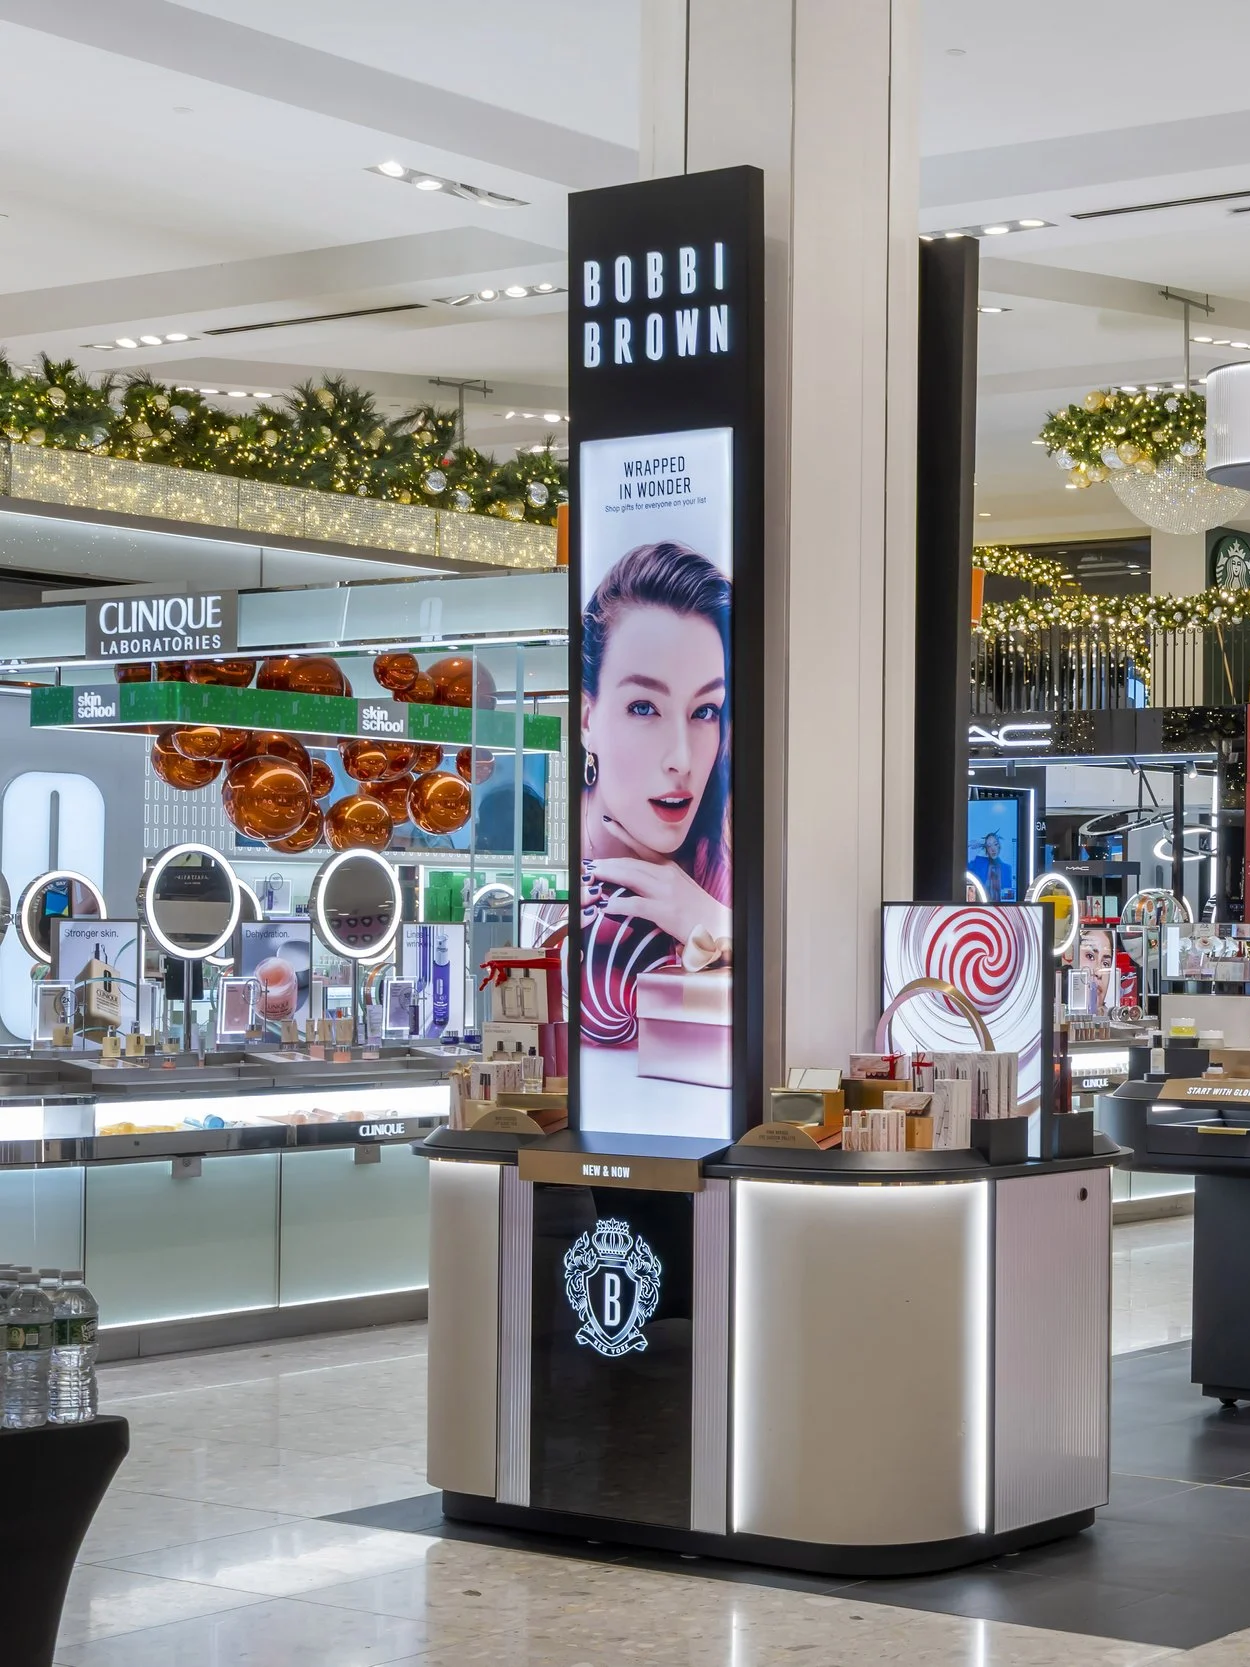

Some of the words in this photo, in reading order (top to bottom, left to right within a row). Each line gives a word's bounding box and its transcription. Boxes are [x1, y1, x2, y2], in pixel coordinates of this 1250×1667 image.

[583, 241, 724, 308] BOBBI
[583, 304, 729, 368] BROWN
[623, 456, 686, 478] WRAPPED
[619, 483, 632, 501] IN
[636, 477, 692, 498] WONDER
[604, 505, 621, 513] Shop
[621, 503, 635, 513] gifts
[644, 501, 673, 509] everyone
[98, 595, 222, 636] CLINIQUE
[100, 634, 222, 655] LABORATORIES
[77, 692, 102, 708] skin
[77, 702, 116, 718] school
[362, 705, 389, 720] skin
[362, 719, 404, 733] school
[968, 724, 1052, 747] AC
[64, 929, 99, 939] Stronger
[100, 930, 119, 938] skin.
[245, 930, 290, 939] Dehydration.
[1082, 1077, 1109, 1089] CLINIQUE
[1187, 1086, 1212, 1095] START
[1212, 1087, 1233, 1096] WITH
[358, 1122, 405, 1137] CLINIQUE
[583, 1164, 601, 1176] NEW
[602, 1165, 610, 1177] &
[611, 1166, 630, 1178] NOW
[604, 1273, 621, 1327] B
[593, 1340, 608, 1352] NEW
[611, 1343, 630, 1355] YORK
